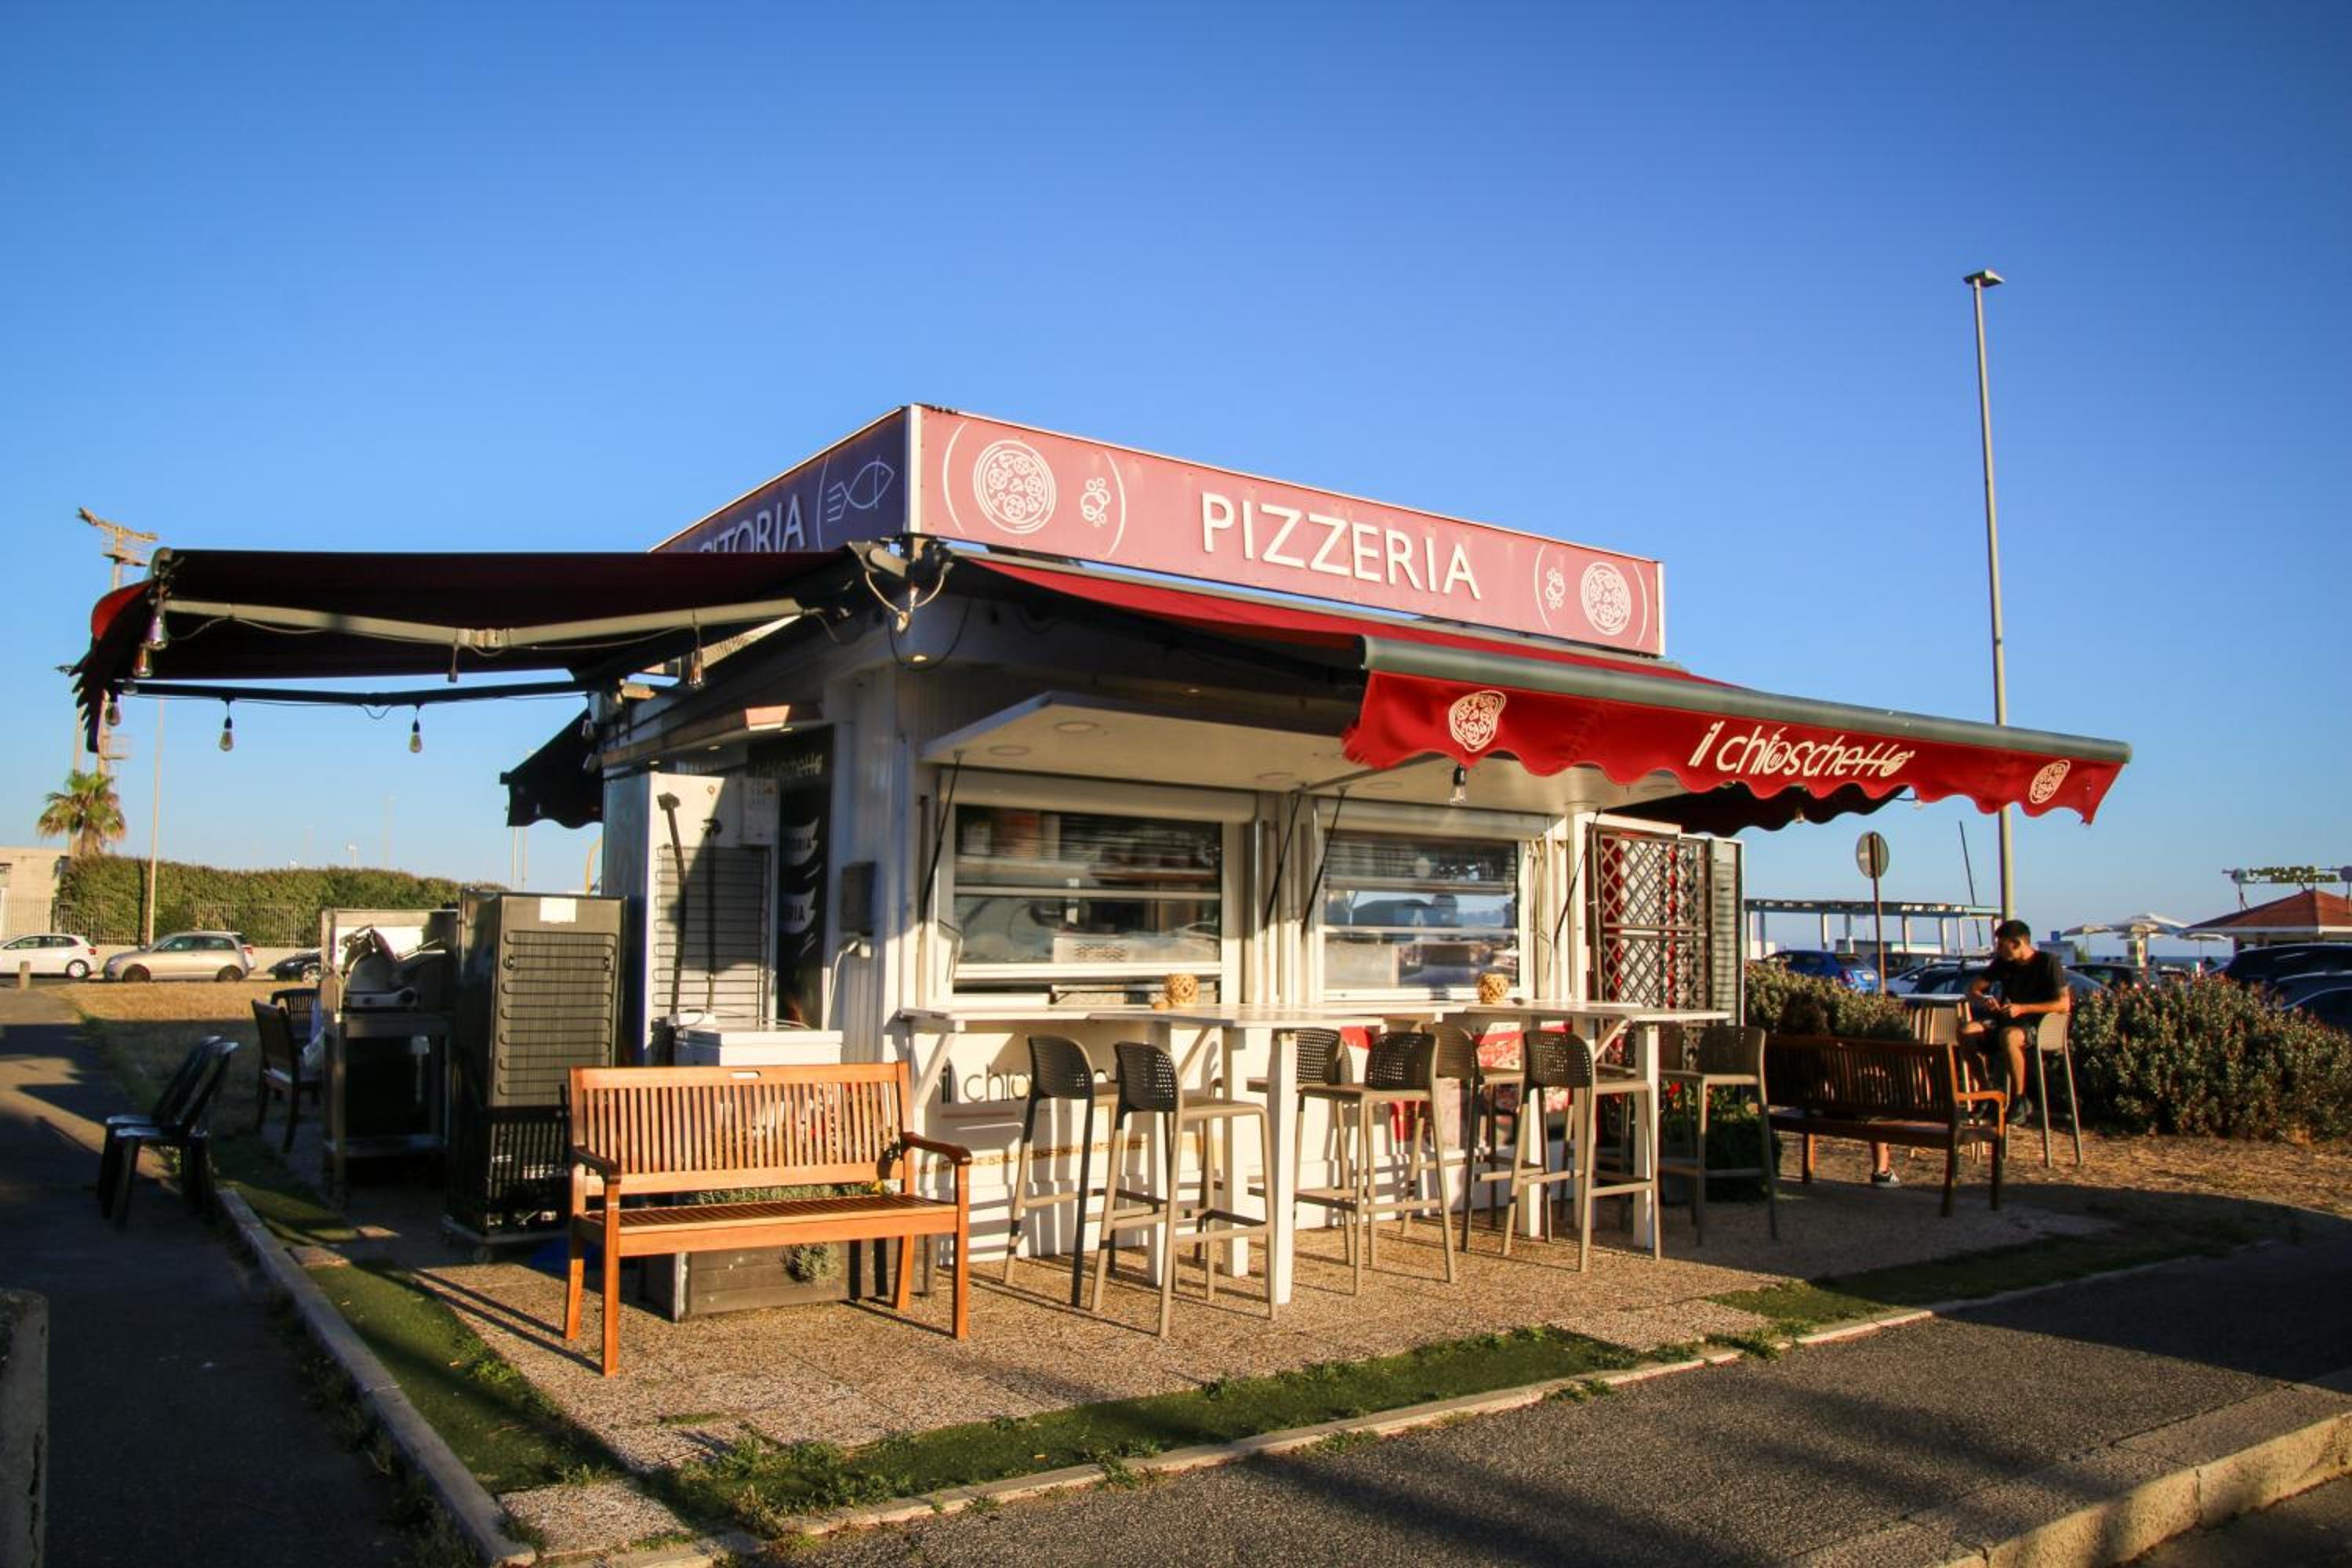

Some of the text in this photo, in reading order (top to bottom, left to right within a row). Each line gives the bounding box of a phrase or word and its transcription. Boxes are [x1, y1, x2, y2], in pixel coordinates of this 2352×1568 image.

[1201, 491, 1481, 601] PIZZERIA
[1688, 720, 1916, 777] il chioschetto
